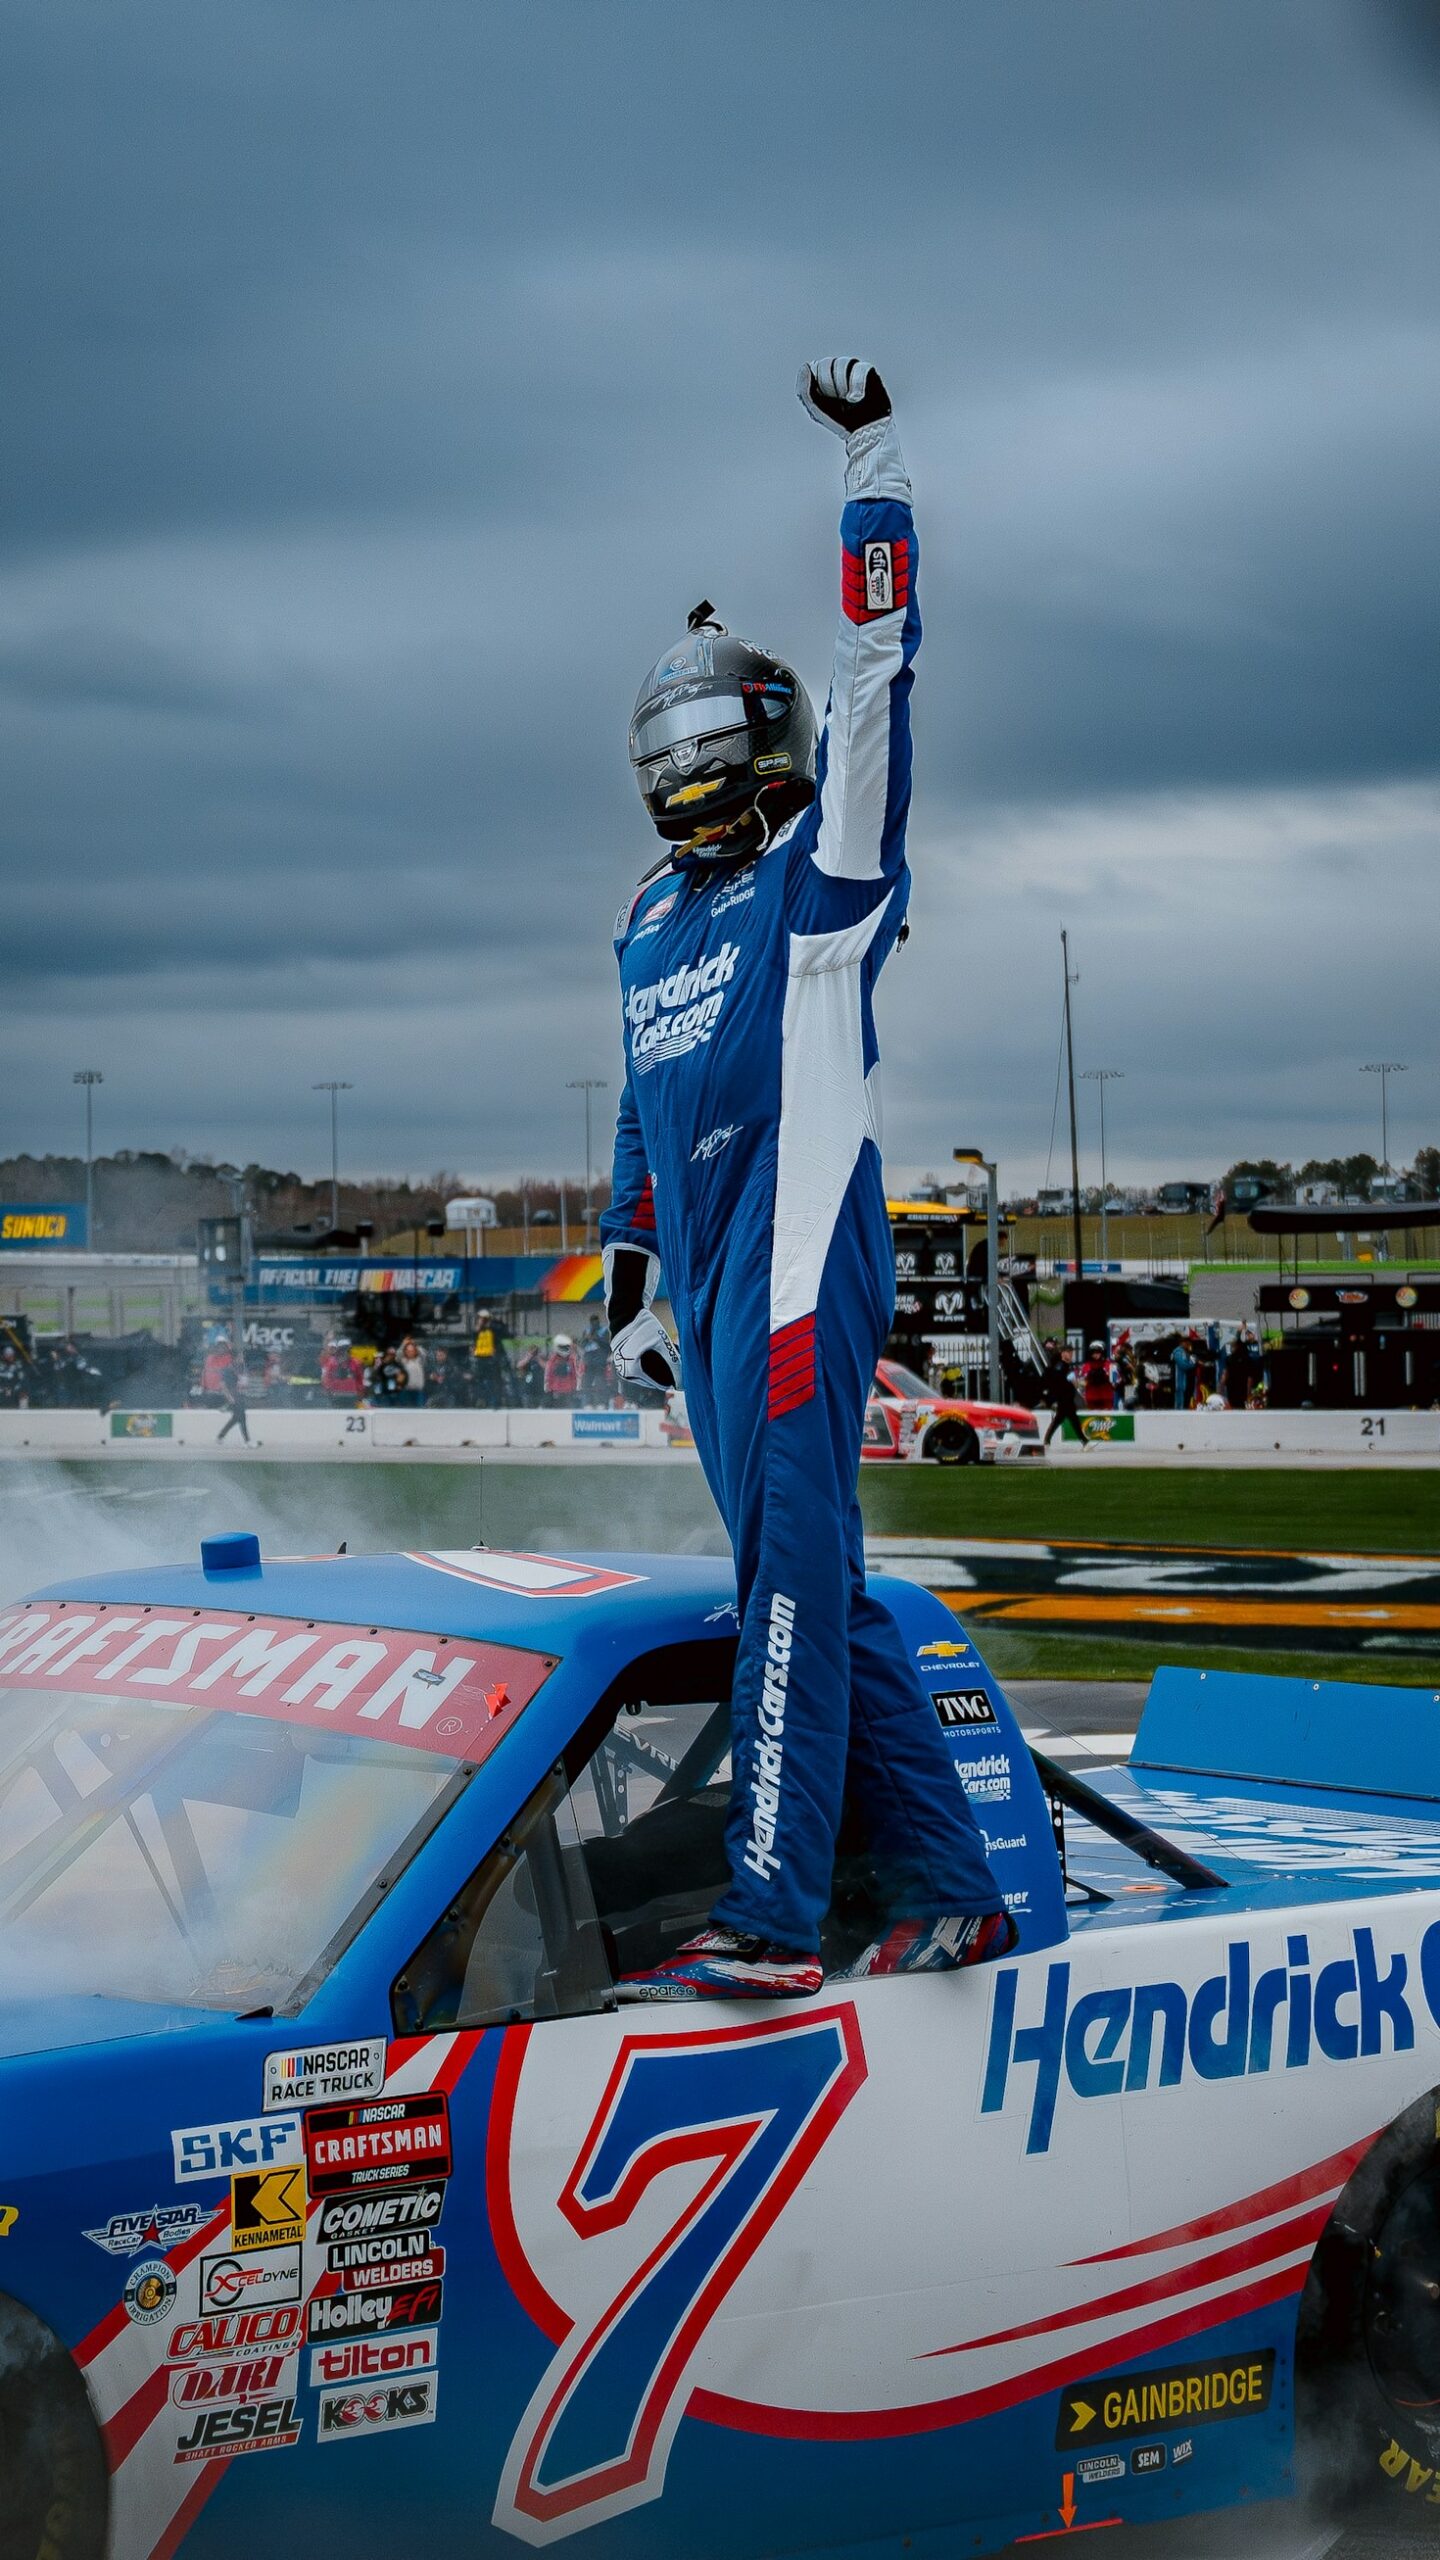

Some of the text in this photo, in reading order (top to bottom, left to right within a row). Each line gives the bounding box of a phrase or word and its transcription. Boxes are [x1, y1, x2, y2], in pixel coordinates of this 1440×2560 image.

[2, 1215, 66, 1239] SUNOCO
[260, 1268, 319, 1285] OFFICIAL
[325, 1268, 359, 1286] FUEL
[346, 1416, 365, 1432] 23
[574, 1421, 620, 1432] Walmart
[1361, 1417, 1385, 1436] 21
[0, 1614, 477, 1731] RAFTSMAN
[920, 1661, 980, 1672] CHEVROLET
[936, 1694, 990, 1722] TWG
[943, 1726, 1001, 1738] MOTORSPORTS
[613, 1722, 680, 1771] EVR
[961, 1775, 1011, 1794] Cars.com
[985, 1834, 1027, 1851] nsGuard
[1002, 1891, 1029, 1905] ner
[639, 1984, 697, 1999] sparco
[981, 1921, 1440, 2155] Hendrick
[303, 2048, 370, 2076] NASCAR
[272, 2071, 375, 2101] RACE TRUCK
[362, 2103, 406, 2123] NASCAR
[180, 2121, 297, 2174] SKF
[314, 2124, 442, 2164] CRAFTSMAN
[108, 2207, 200, 2237] FIVE STAR
[323, 2192, 441, 2234] COMETIC
[163, 2227, 191, 2238] Bodies
[234, 2225, 304, 2248] KENNAMETAL
[330, 2226, 376, 2240] GASKET
[332, 2234, 425, 2269] LINCOLN
[130, 2263, 172, 2286] CHAMPION
[353, 2258, 434, 2287] WELDERS
[505, 2001, 869, 2536] 7
[129, 2297, 172, 2323] IRRIGATION
[310, 2294, 393, 2333] Holley
[168, 2304, 301, 2359] CALICO
[235, 2339, 298, 2357] COATINGS
[318, 2340, 430, 2381] tilton
[321, 2381, 431, 2432] KOOKS
[1103, 2365, 1263, 2429] GAINBRIDGE
[177, 2398, 301, 2450] JESEL
[185, 2435, 287, 2460] SHAFT ROCKER ARMS
[1137, 2450, 1160, 2468] SEM
[1172, 2439, 1193, 2459] WIX
[1079, 2457, 1118, 2472] LINCOLN
